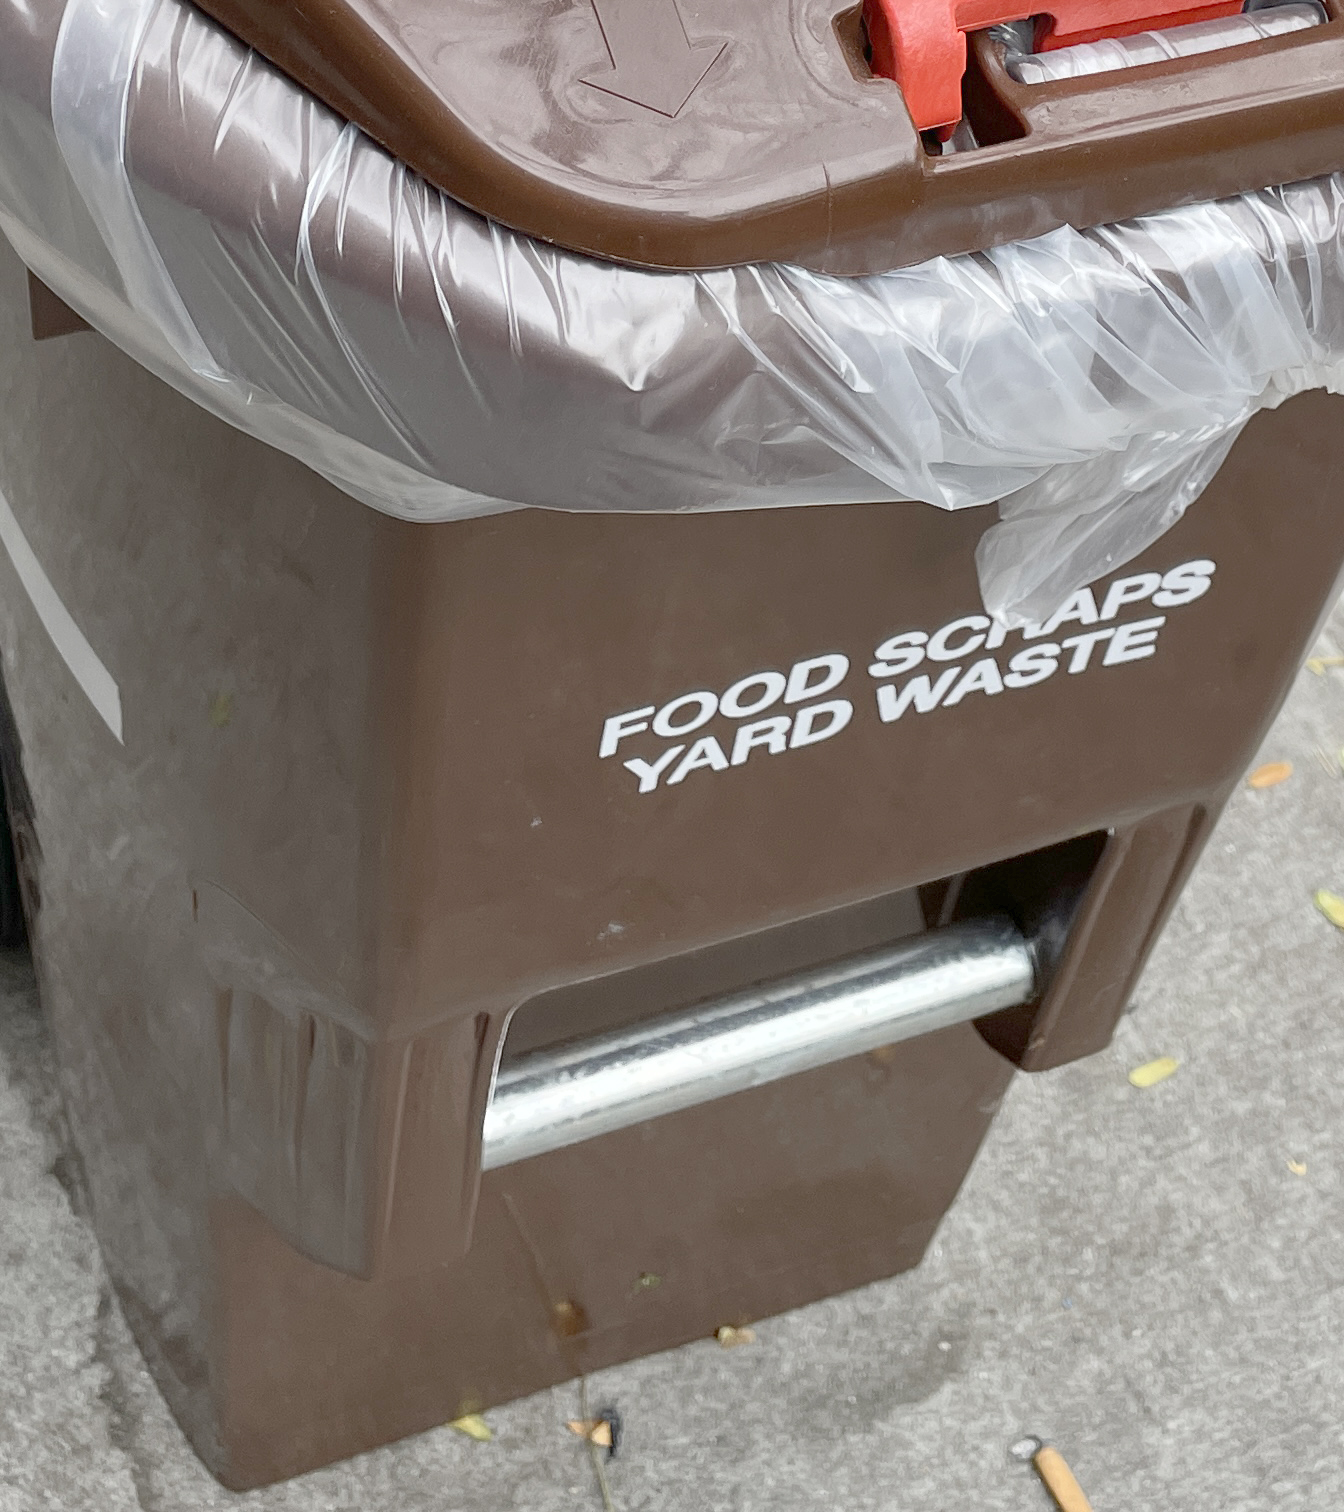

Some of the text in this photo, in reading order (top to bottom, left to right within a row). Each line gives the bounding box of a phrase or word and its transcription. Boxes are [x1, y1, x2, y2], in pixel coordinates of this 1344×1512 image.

[599, 653, 849, 759] FOOD
[623, 616, 1166, 793] YARD WASTE
